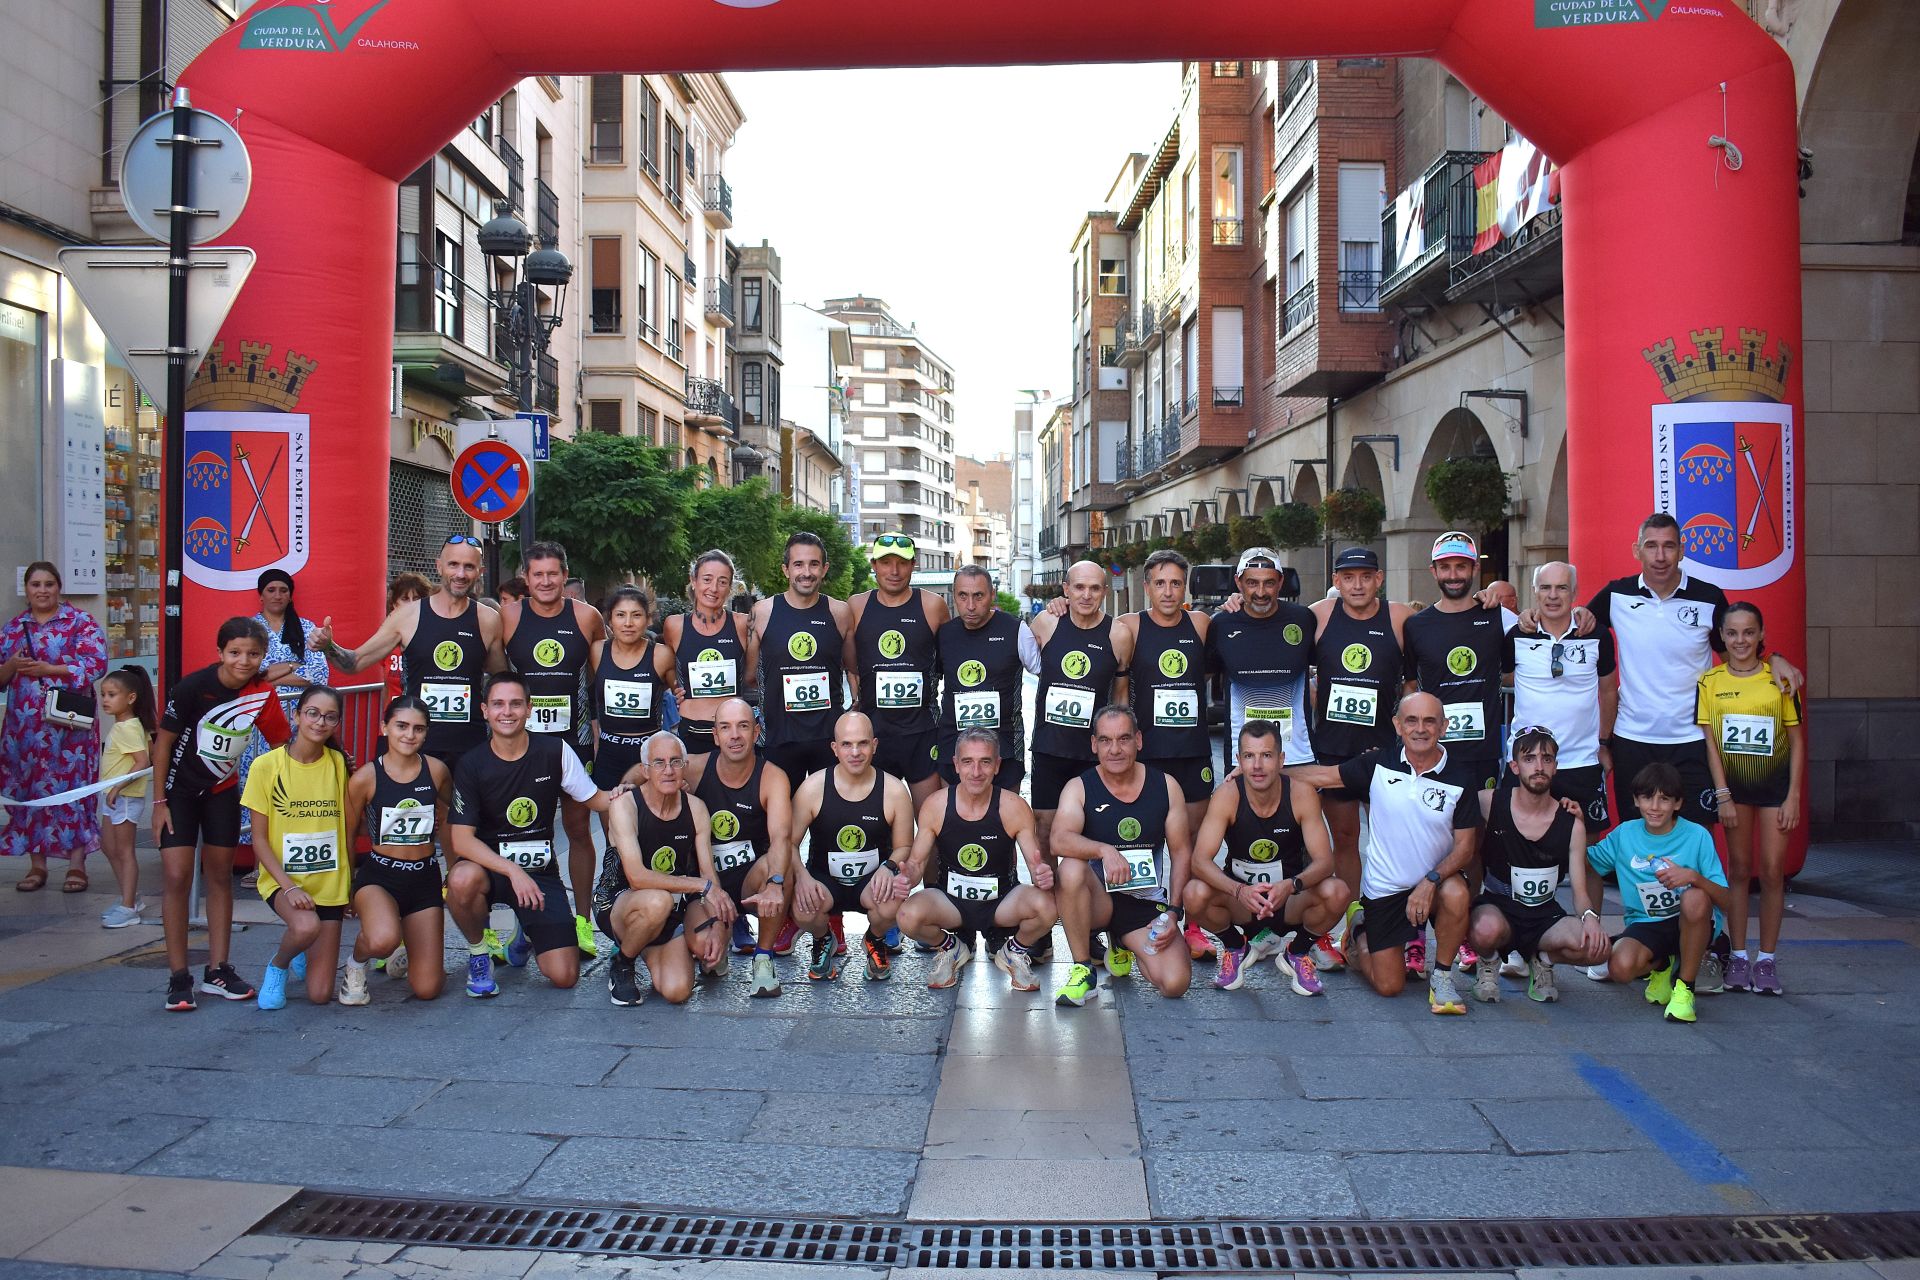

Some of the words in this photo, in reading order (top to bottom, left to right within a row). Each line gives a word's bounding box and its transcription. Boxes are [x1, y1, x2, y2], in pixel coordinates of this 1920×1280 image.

[1550, 2, 1595, 11] CIUDAD
[1601, 0, 1614, 8] DE
[1670, 6, 1724, 18] CALAHORRA
[1562, 10, 1640, 25] VERDURA
[254, 27, 288, 36] CIUDAD
[292, 27, 304, 35] DE
[308, 27, 321, 36] LA
[260, 38, 326, 50] VERDURA
[358, 39, 420, 50] CALAHORRA
[1658, 424, 1668, 454] SAN
[296, 432, 304, 463] SAN
[535, 449, 546, 458] WC
[296, 468, 304, 553] EMETERIO
[701, 672, 726, 688] 34
[796, 685, 820, 702] 68
[882, 682, 918, 698] 192
[425, 696, 466, 712] 213
[614, 692, 640, 708] 35
[1056, 700, 1082, 716] 40
[1334, 696, 1372, 714] 189
[535, 708, 558, 723] 191
[960, 703, 996, 720] 228
[1165, 702, 1190, 716] 66
[212, 734, 232, 752] 91
[1727, 726, 1768, 744] 214
[165, 768, 177, 790] San
[174, 727, 192, 766] Adrian
[393, 818, 422, 834] 37
[288, 844, 332, 862] 286
[506, 852, 546, 868] 195
[712, 850, 750, 870] 193
[392, 860, 424, 870] PRO
[842, 862, 868, 876] 67
[954, 884, 993, 900] 187
[1523, 880, 1549, 896] 96
[1645, 892, 1680, 908] 28
